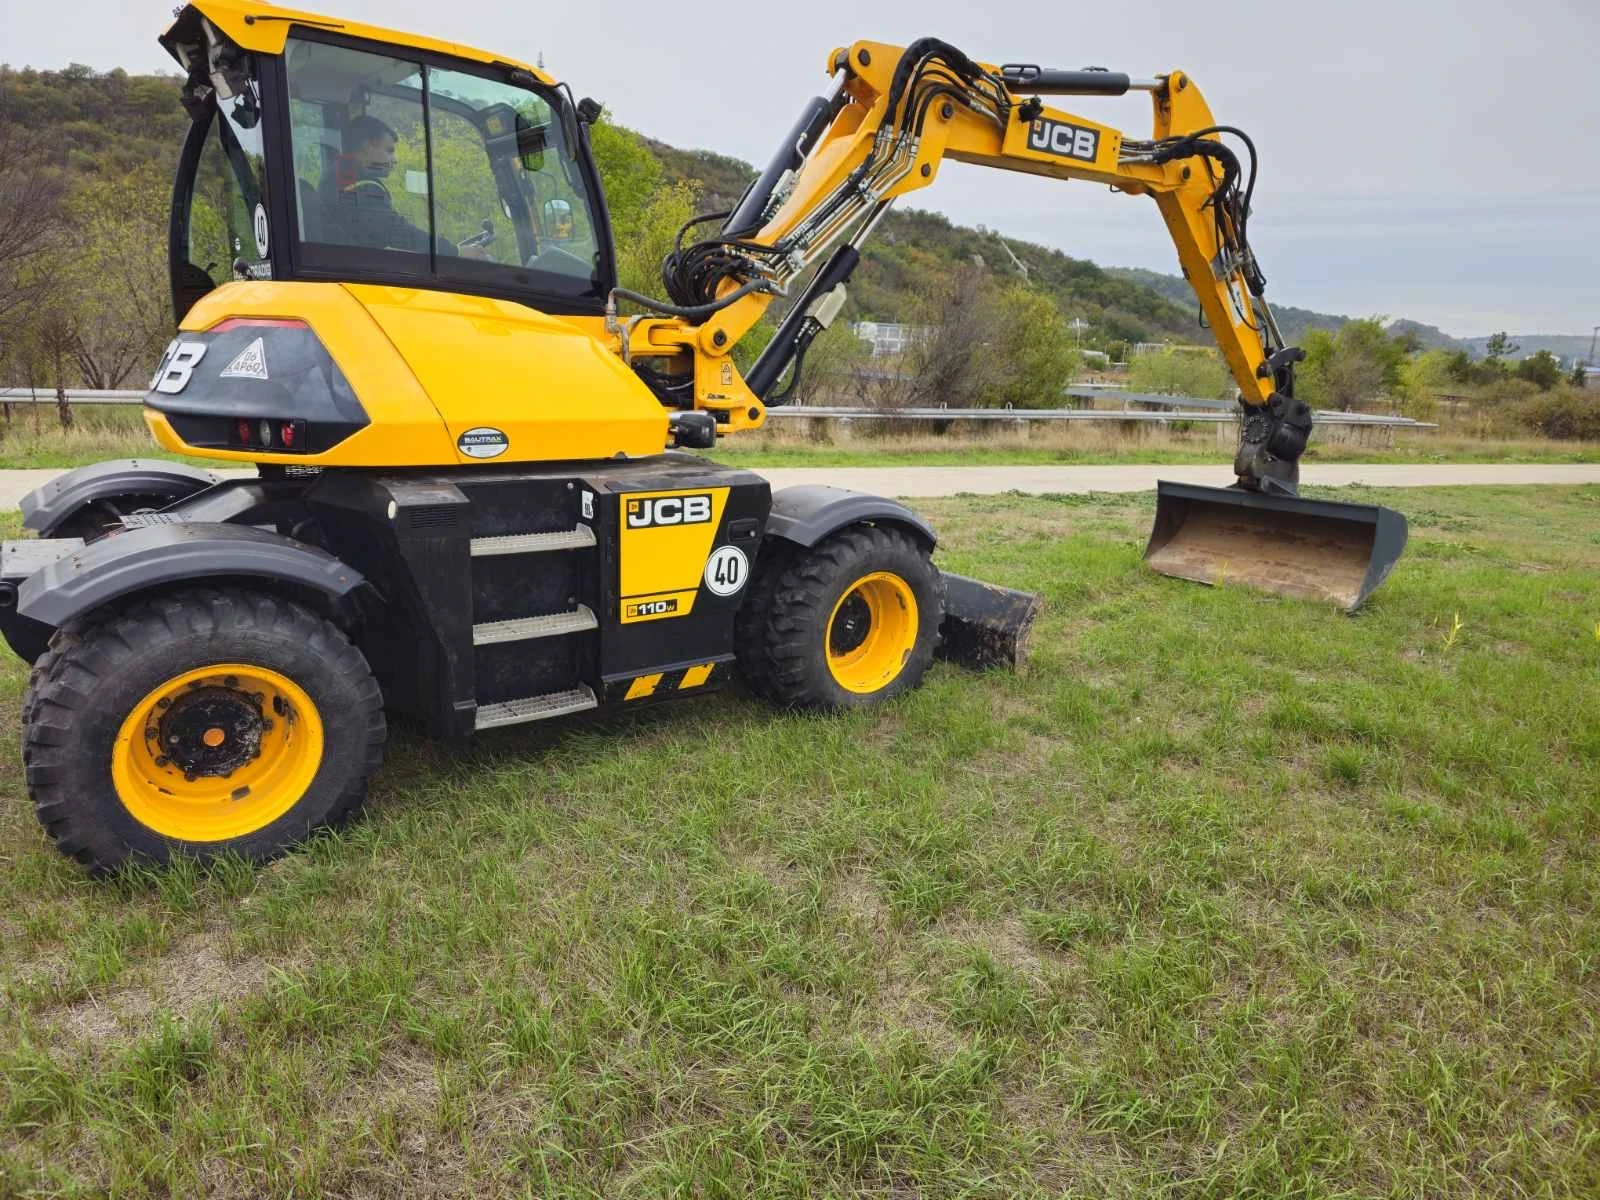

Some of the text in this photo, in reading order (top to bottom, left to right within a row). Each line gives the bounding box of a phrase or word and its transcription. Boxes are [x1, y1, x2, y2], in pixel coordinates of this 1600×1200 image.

[1032, 121, 1095, 158] JCB
[628, 496, 711, 527] JCB
[714, 556, 739, 585] 40
